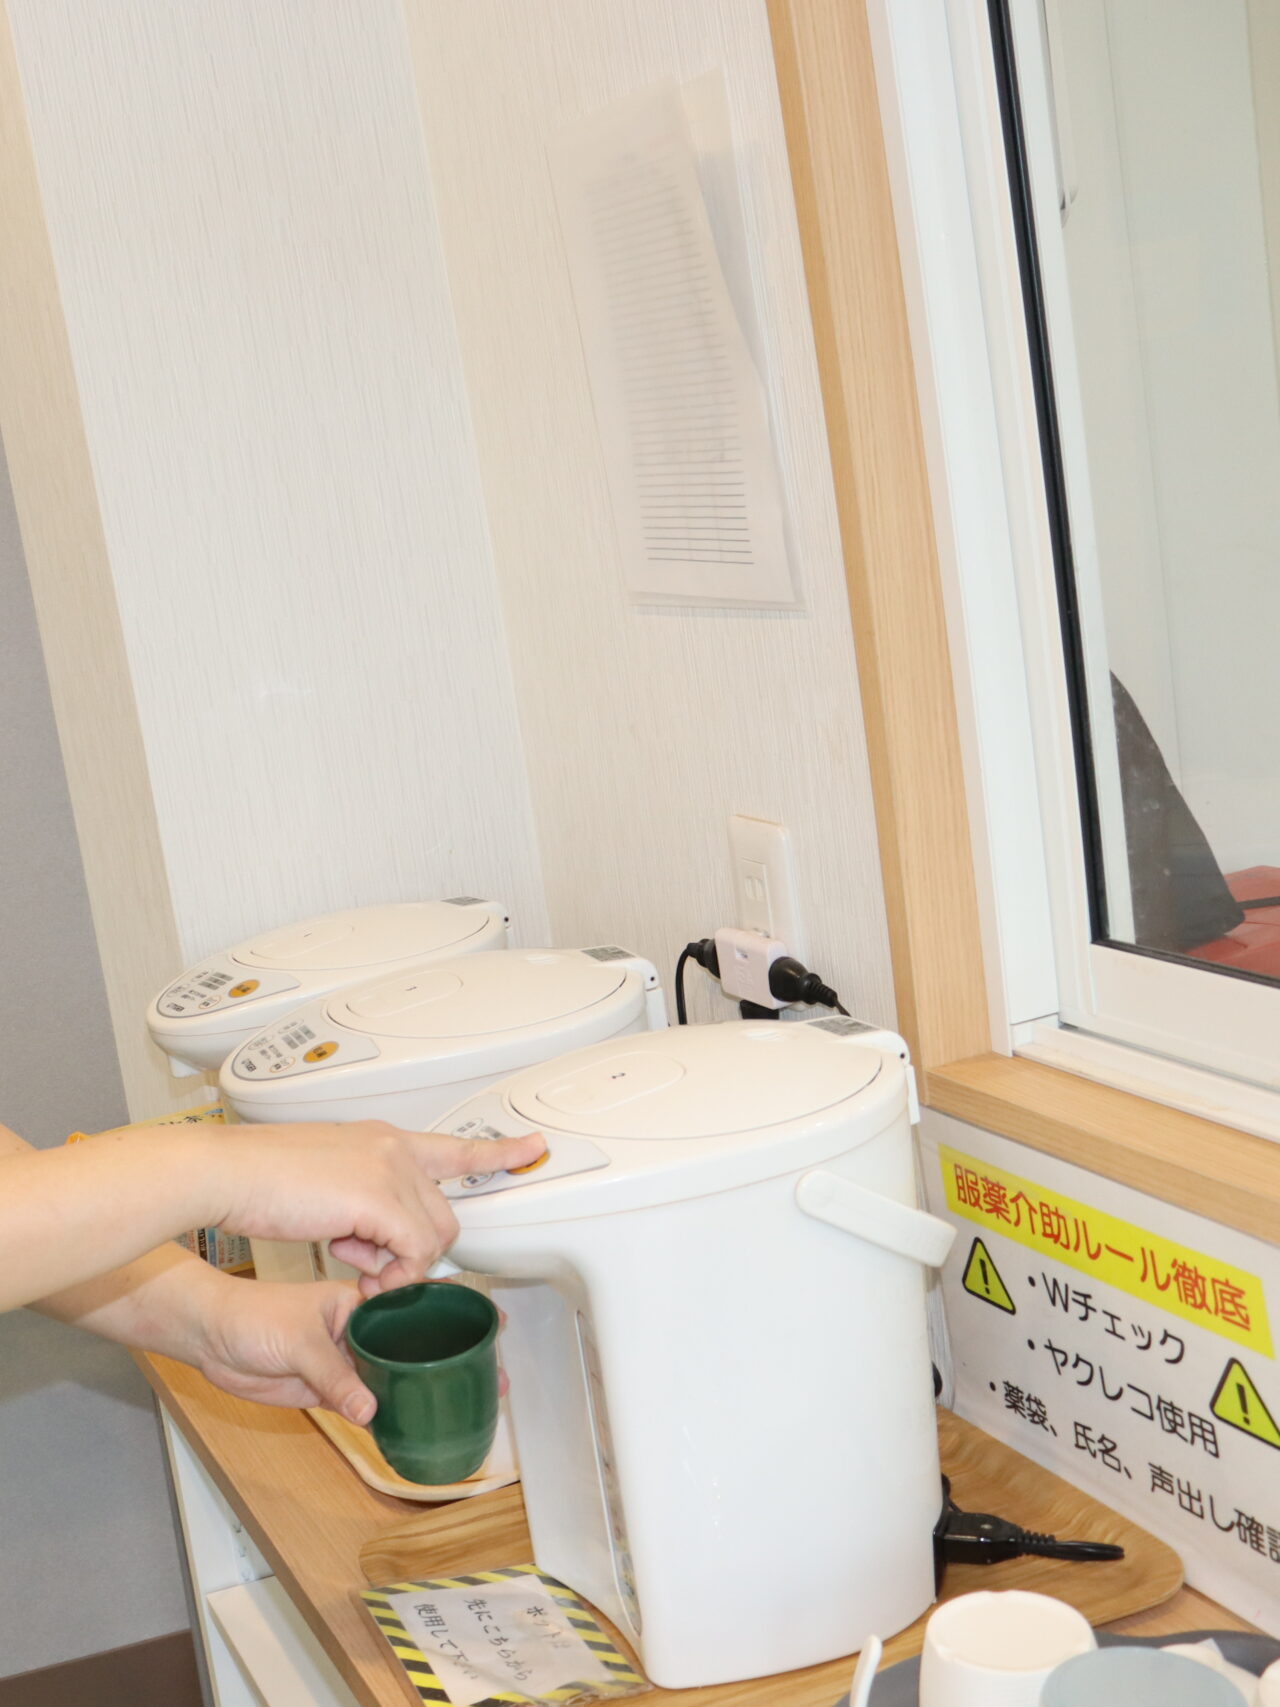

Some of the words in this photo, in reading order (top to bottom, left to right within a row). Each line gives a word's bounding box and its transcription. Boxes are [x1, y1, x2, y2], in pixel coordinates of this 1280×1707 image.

[955, 1164, 1251, 1332] 服薬介助ルール徹底
